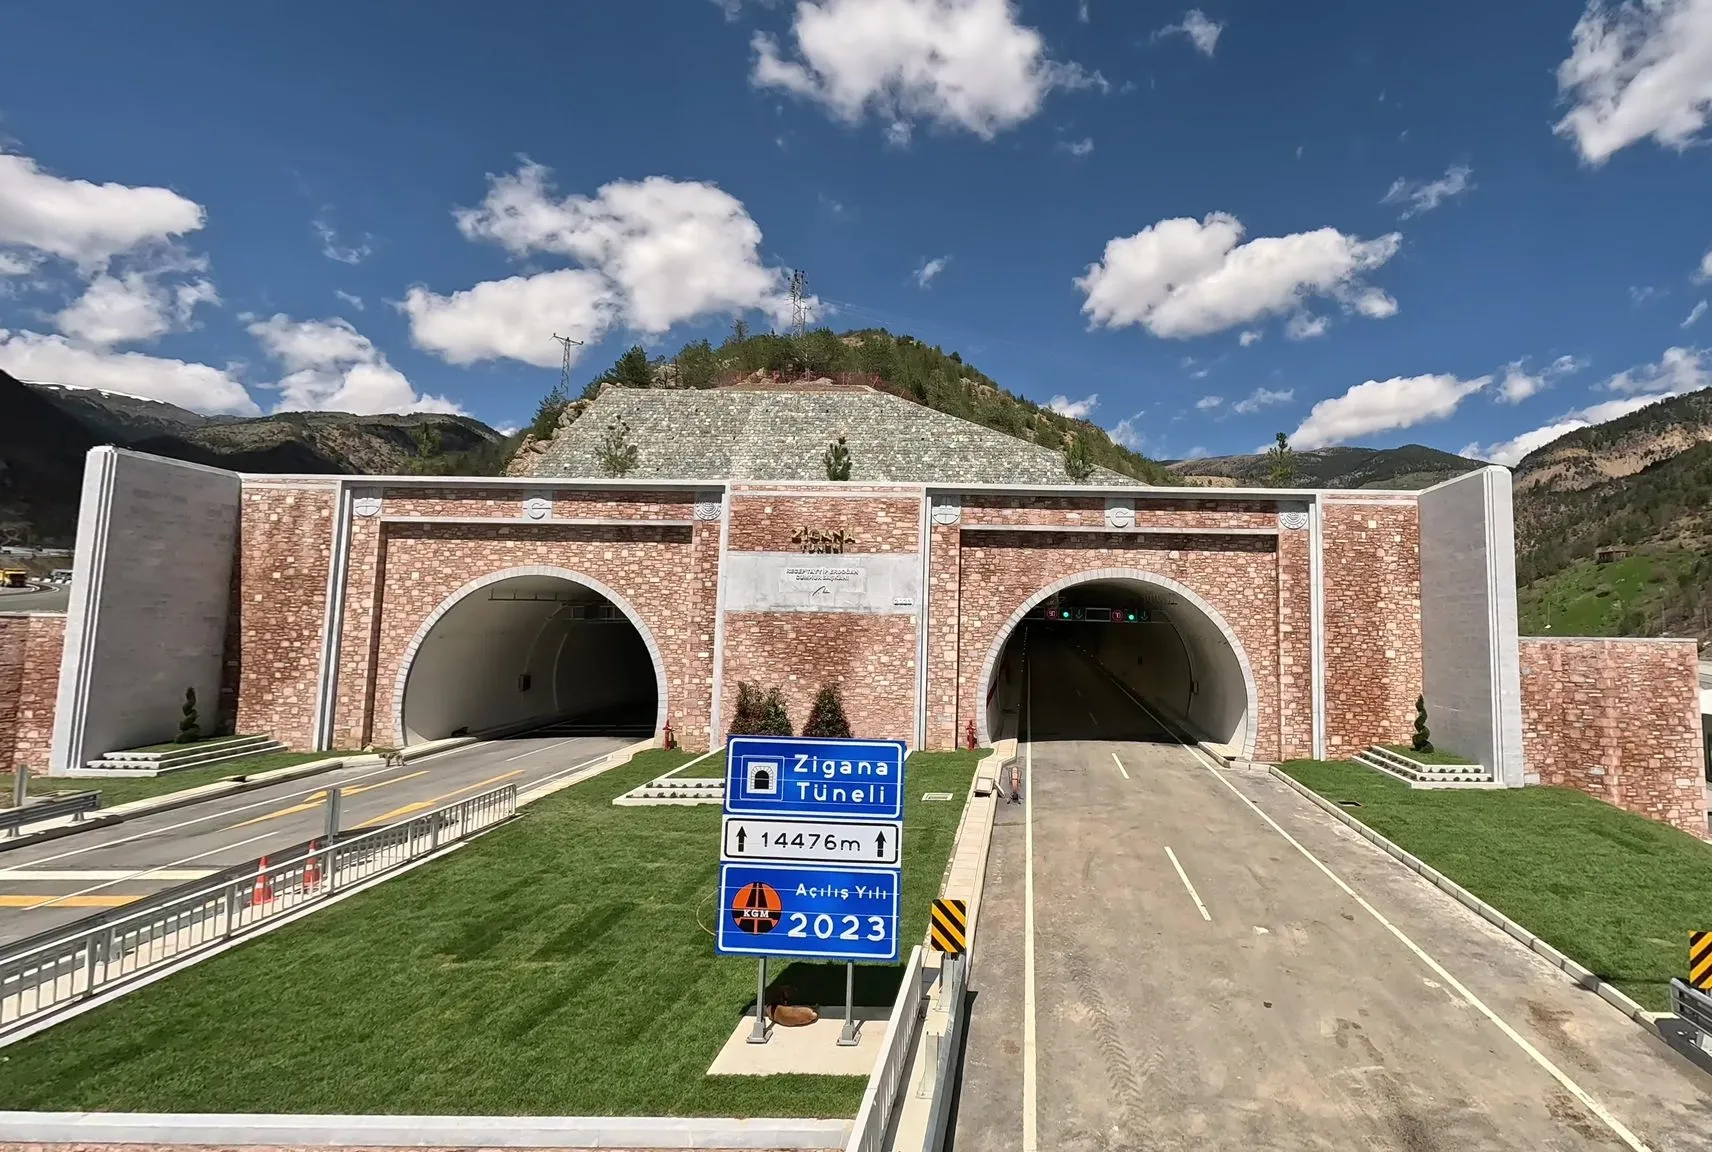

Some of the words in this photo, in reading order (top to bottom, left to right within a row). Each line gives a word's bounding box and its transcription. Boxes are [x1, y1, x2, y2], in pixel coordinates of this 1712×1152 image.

[793, 754, 888, 778] Zigana
[796, 782, 885, 803] Tüneli
[761, 832, 861, 851] 14476m
[795, 883, 849, 900] Açılış
[855, 885, 887, 900] Yılı
[743, 909, 769, 918] KGM
[787, 912, 886, 942] 2023
